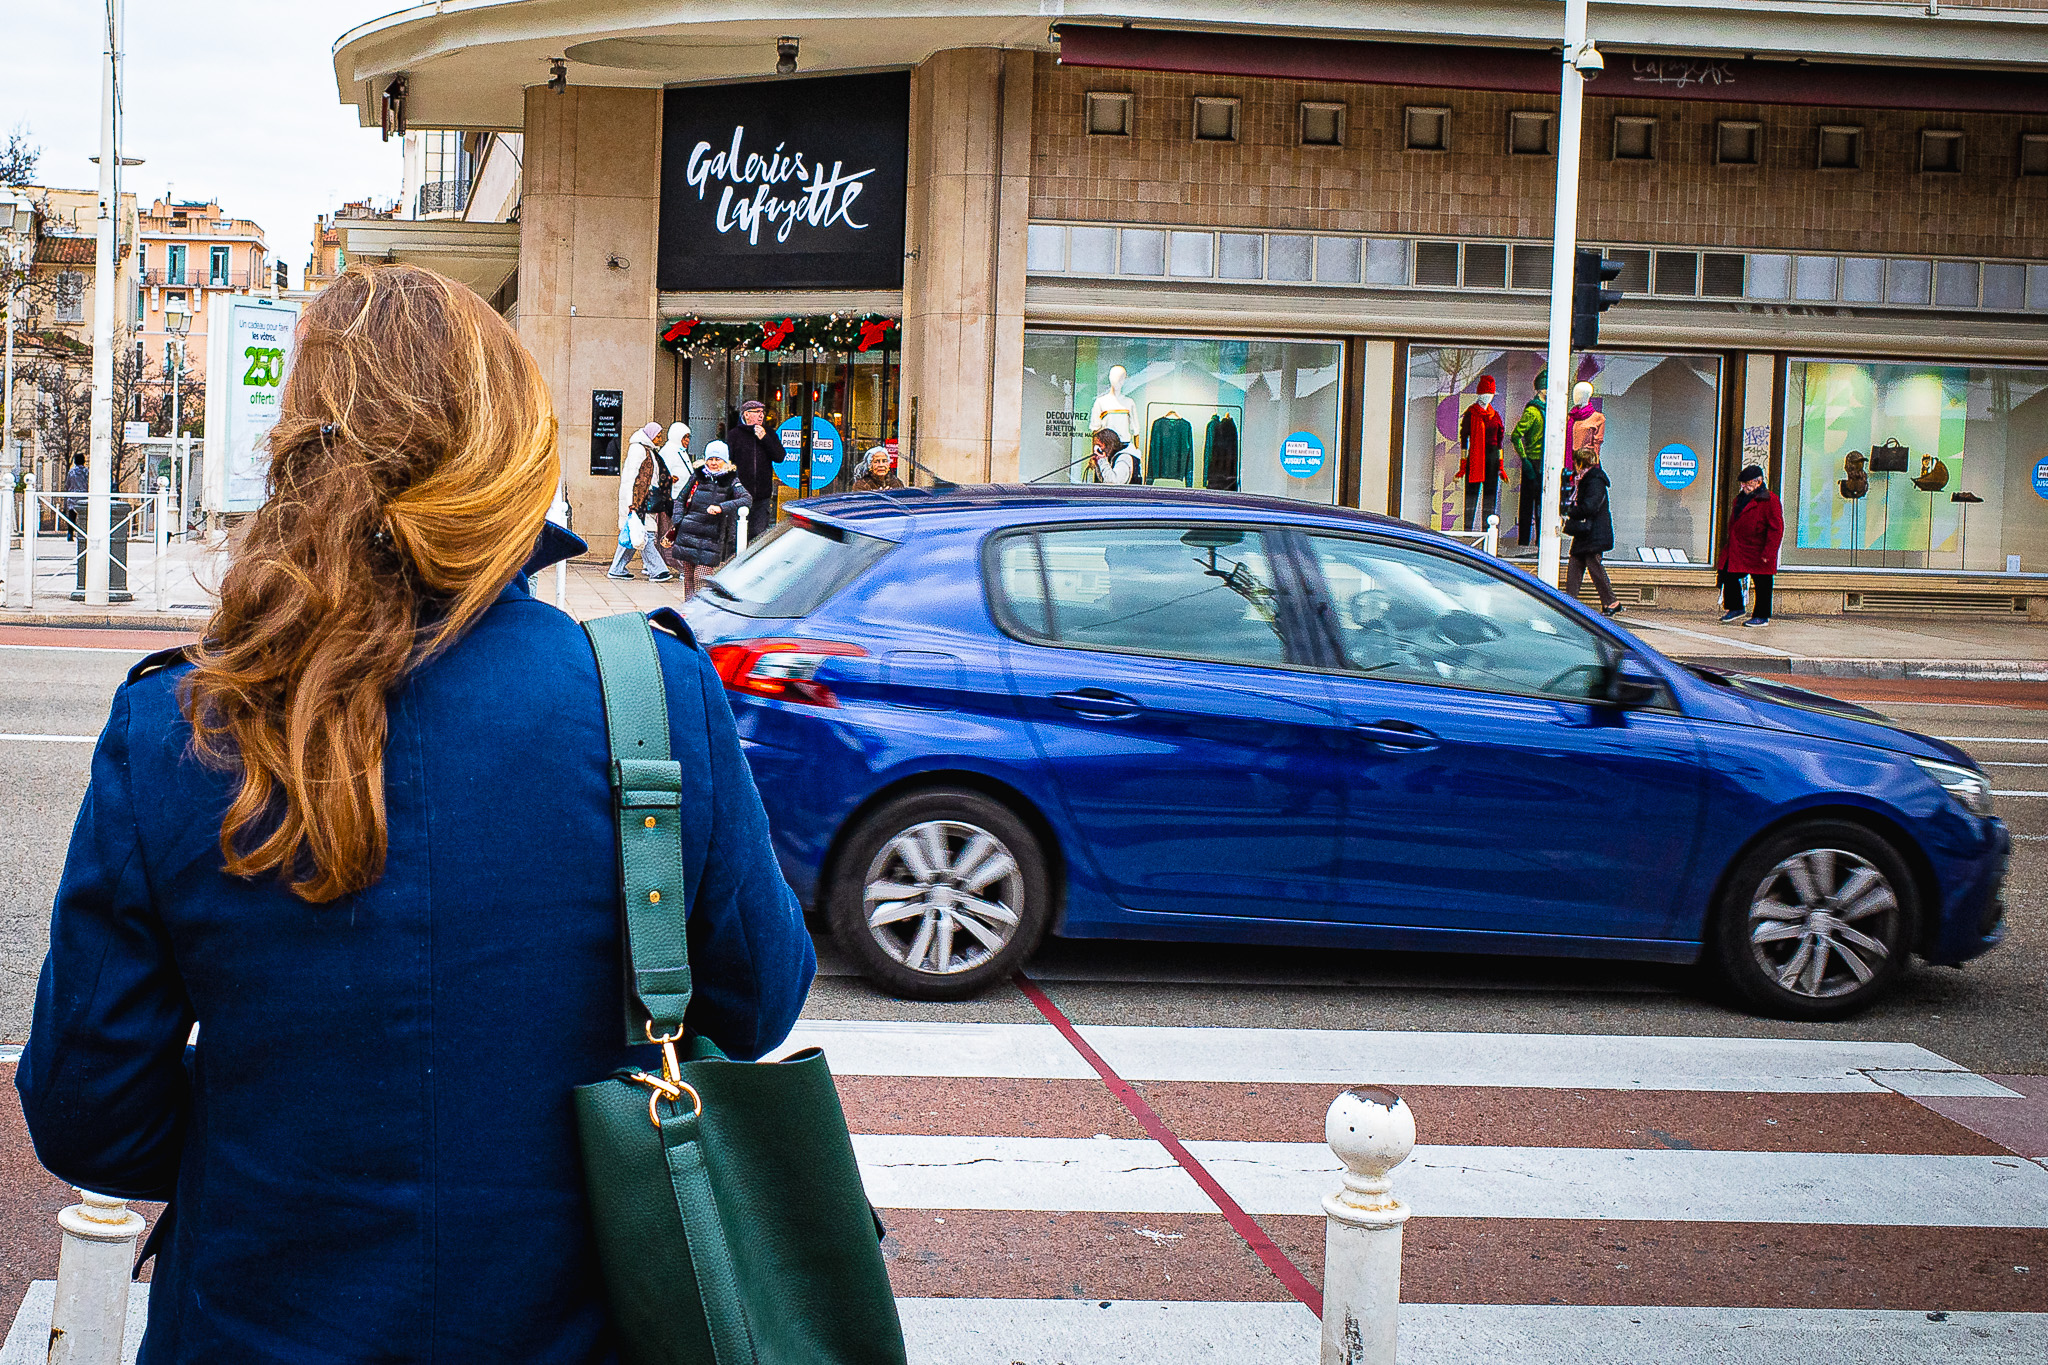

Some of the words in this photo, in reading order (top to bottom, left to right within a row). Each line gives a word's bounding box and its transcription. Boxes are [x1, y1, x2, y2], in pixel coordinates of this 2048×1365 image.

[687, 126, 809, 200] Galeries
[717, 161, 876, 245] Lafayette
[248, 321, 265, 329] cadeau
[267, 323, 278, 331] pour
[250, 392, 275, 404] offerts
